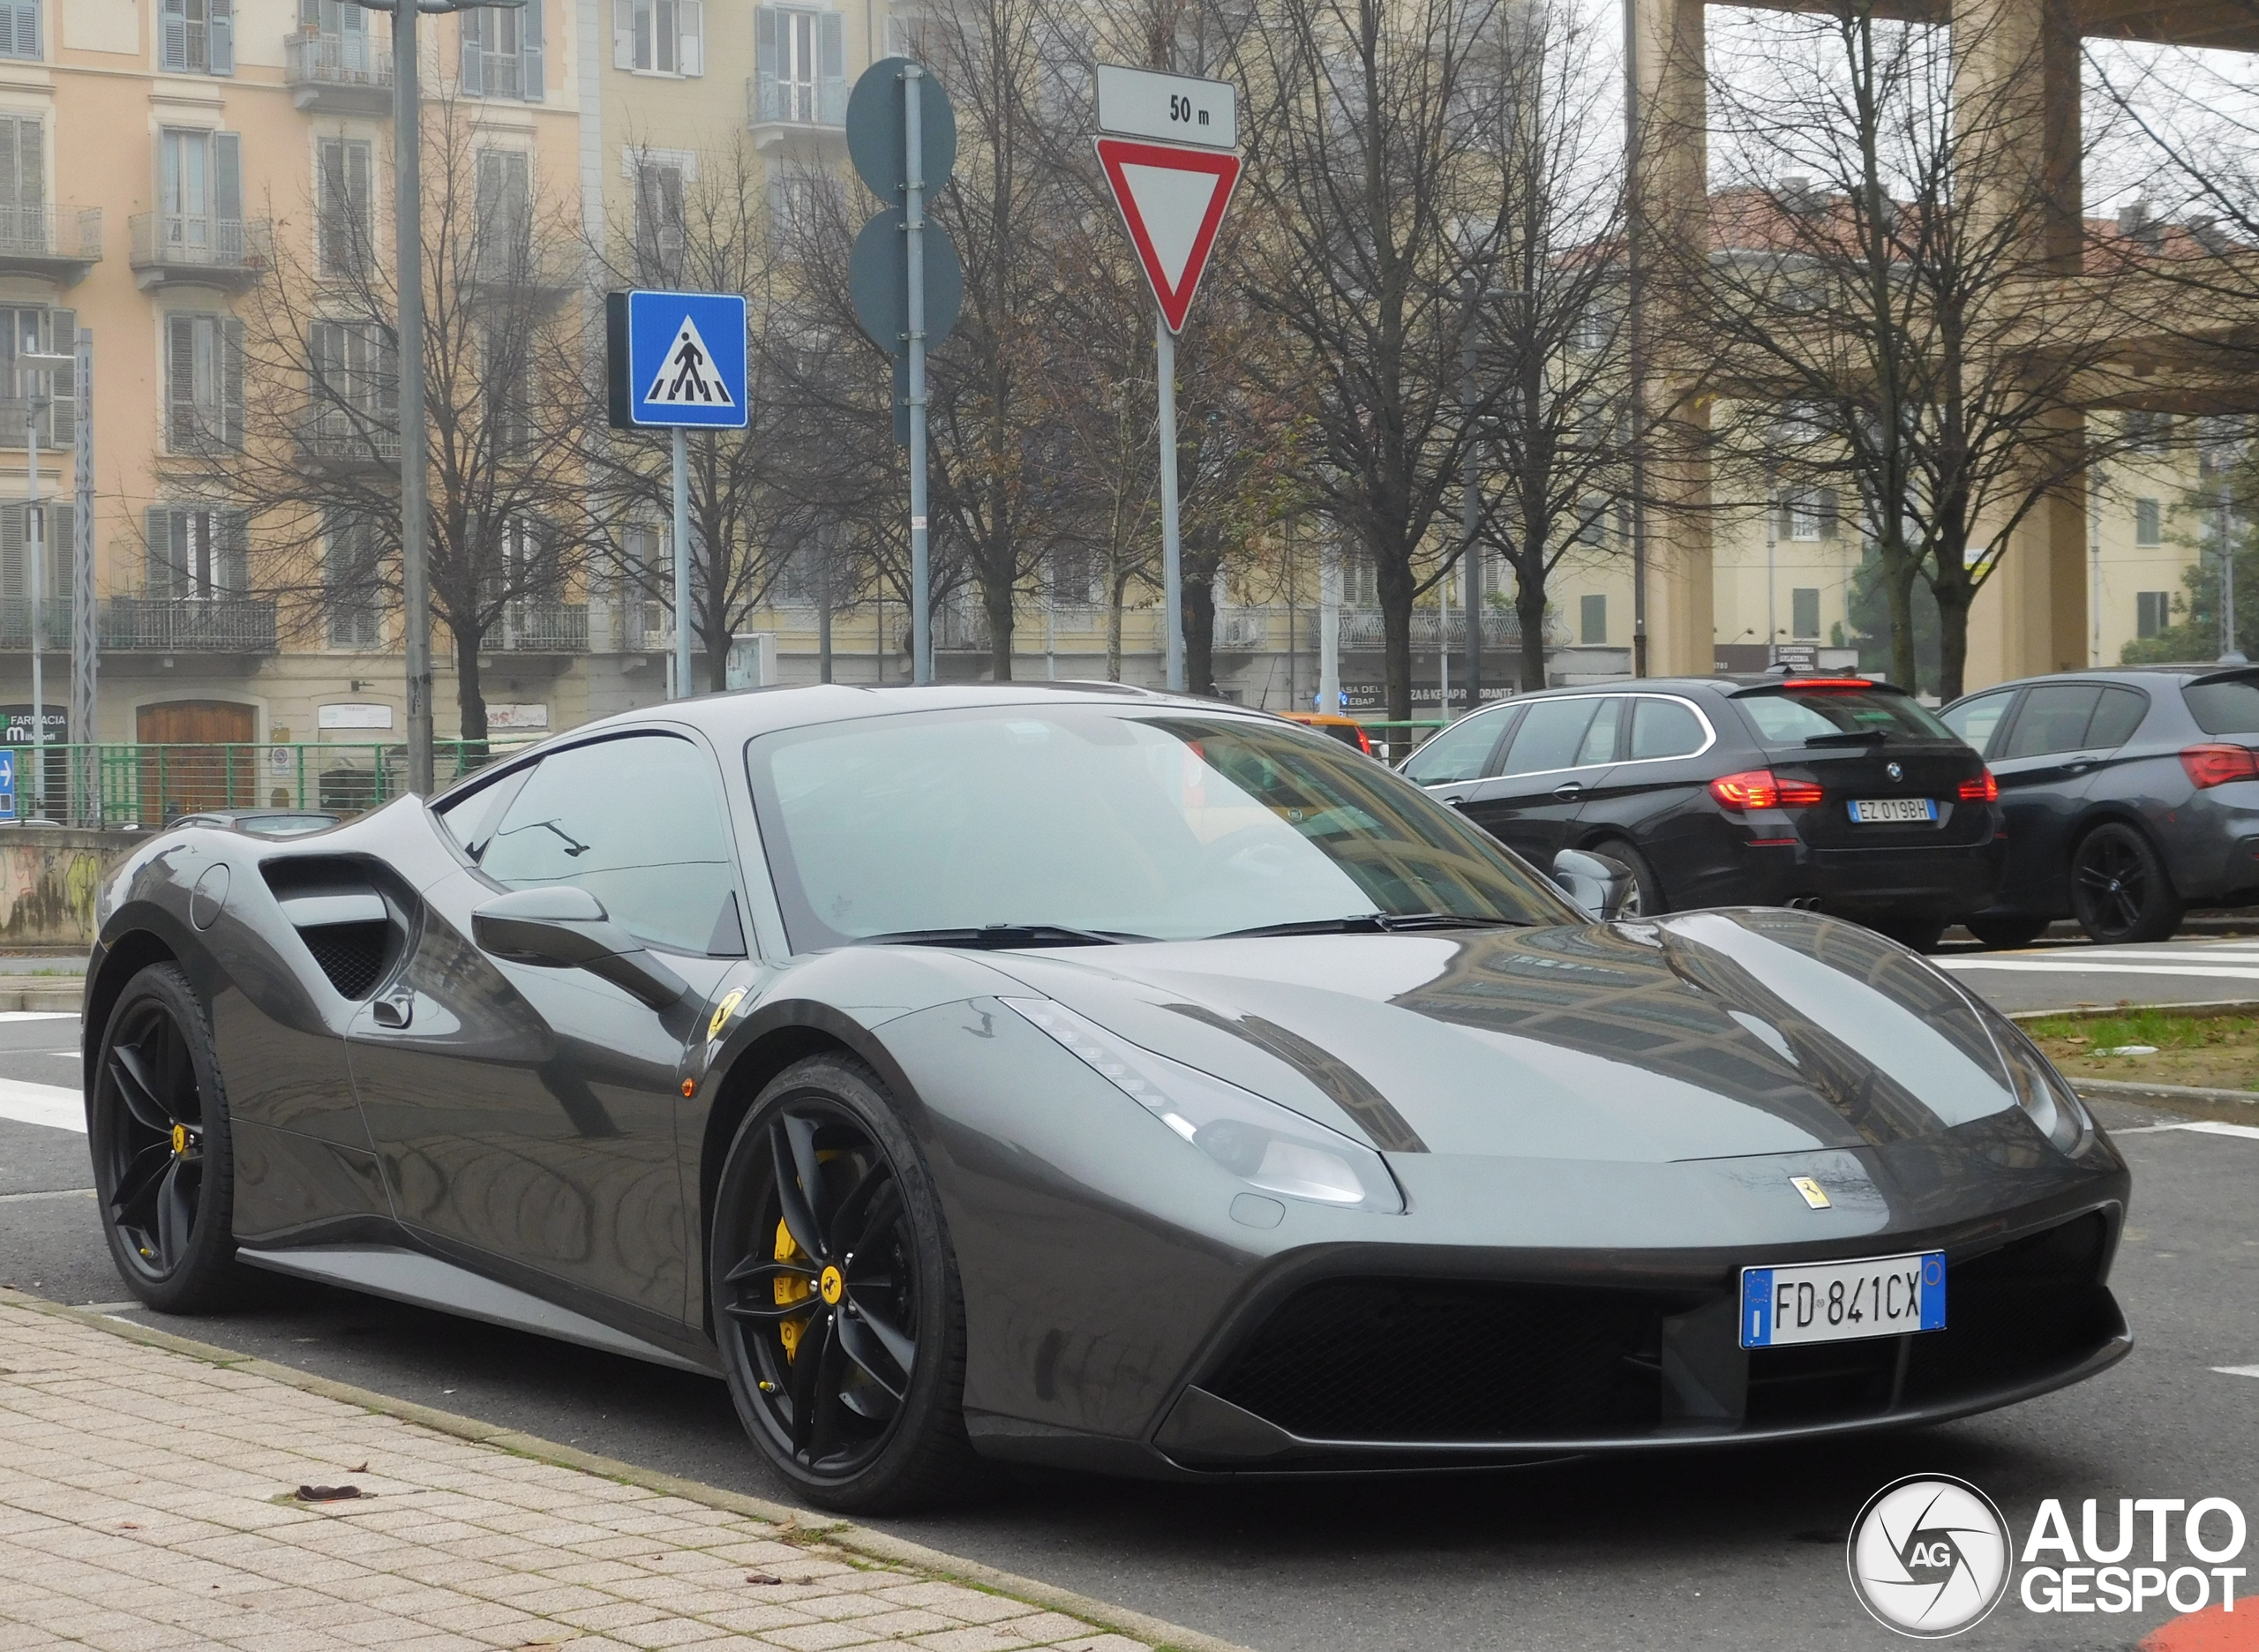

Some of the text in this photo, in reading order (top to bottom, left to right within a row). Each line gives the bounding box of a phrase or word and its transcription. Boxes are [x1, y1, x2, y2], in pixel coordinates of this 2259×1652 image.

[1170, 94, 1210, 125] 50 m
[1362, 685, 1381, 694] DEL
[1430, 688, 1460, 700] KEAP
[1460, 687, 1513, 699] RORANTE
[1349, 697, 1376, 706] EBAP
[1858, 801, 1879, 820] EZ
[1881, 800, 1928, 820] 019BH
[1775, 1281, 1815, 1329] FD
[1827, 1271, 1920, 1326] 841CX
